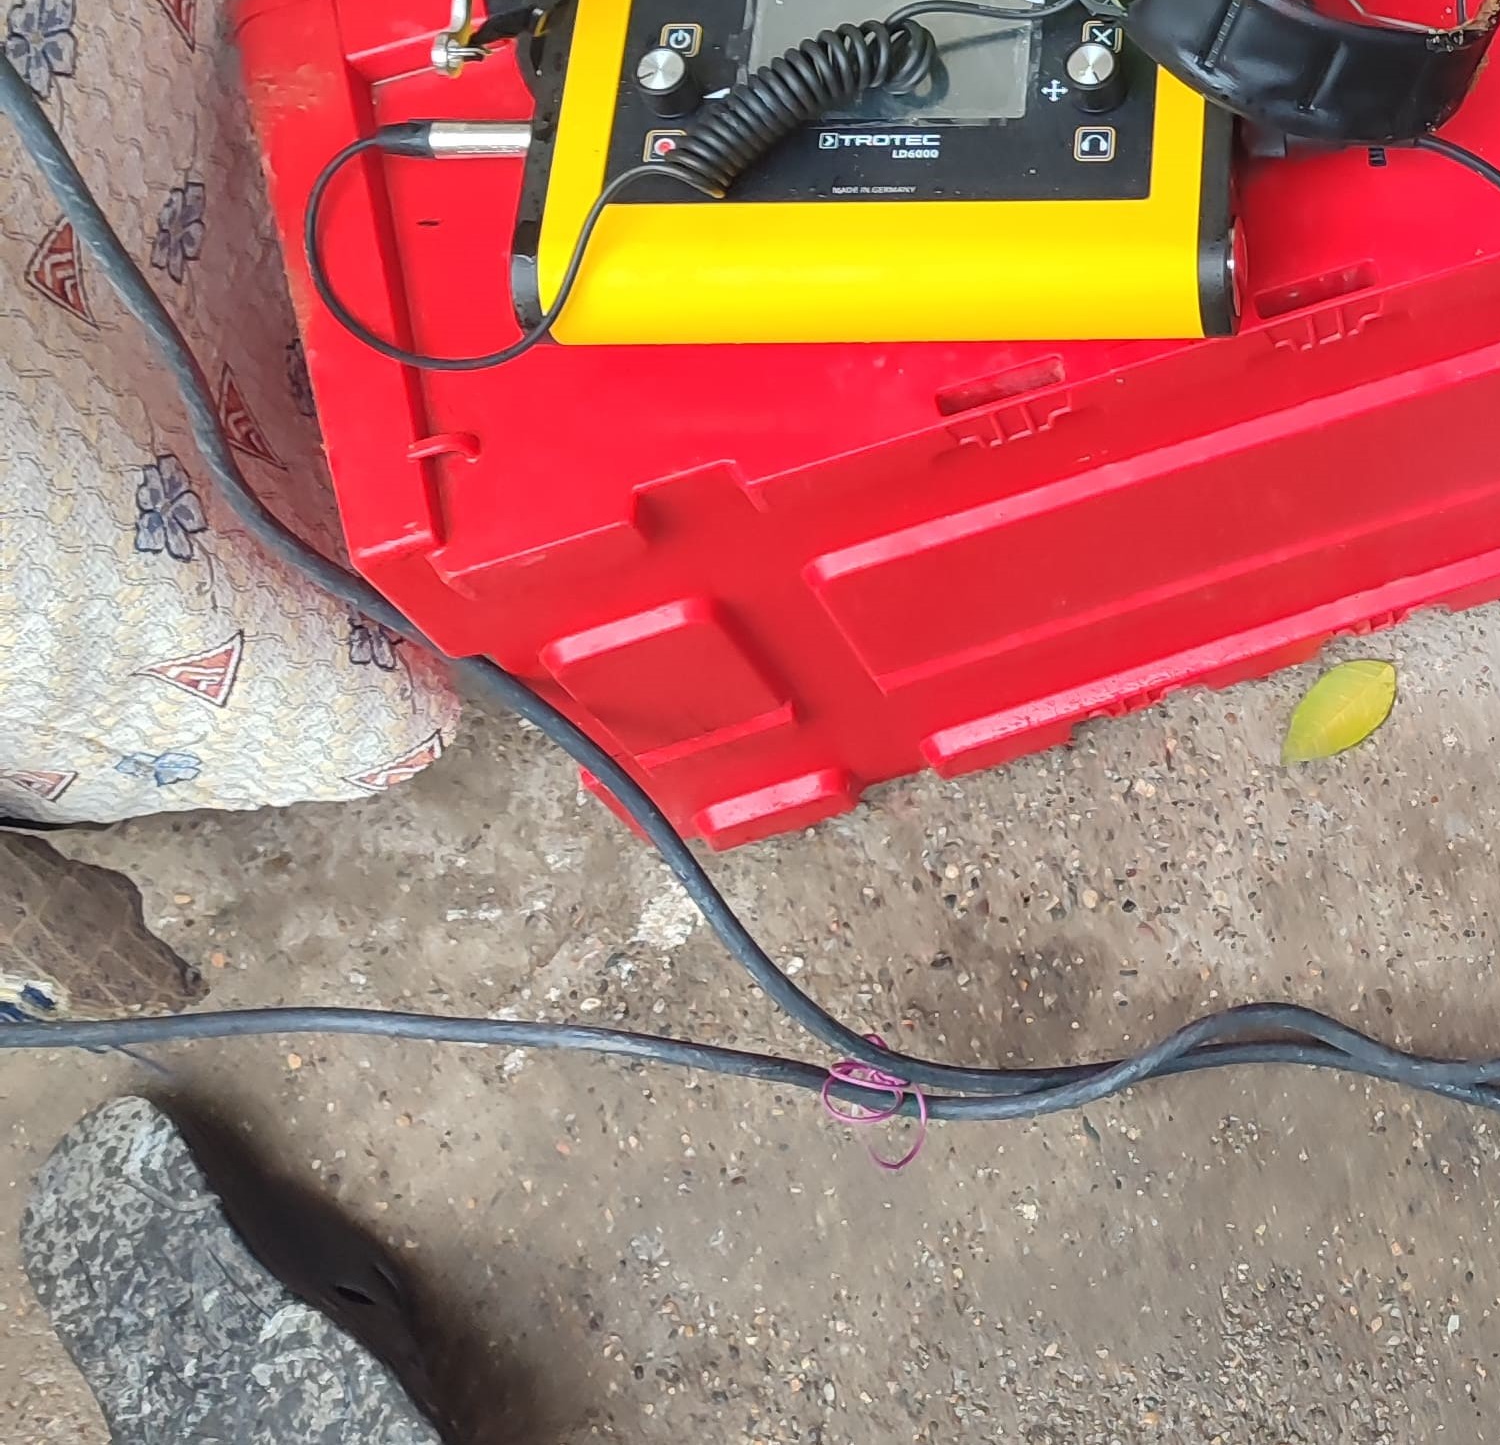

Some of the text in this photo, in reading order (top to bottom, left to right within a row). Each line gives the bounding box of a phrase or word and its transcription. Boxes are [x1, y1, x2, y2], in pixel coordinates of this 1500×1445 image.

[838, 134, 941, 146] TROTEC
[892, 149, 939, 158] LD6000
[832, 186, 858, 194] MADE
